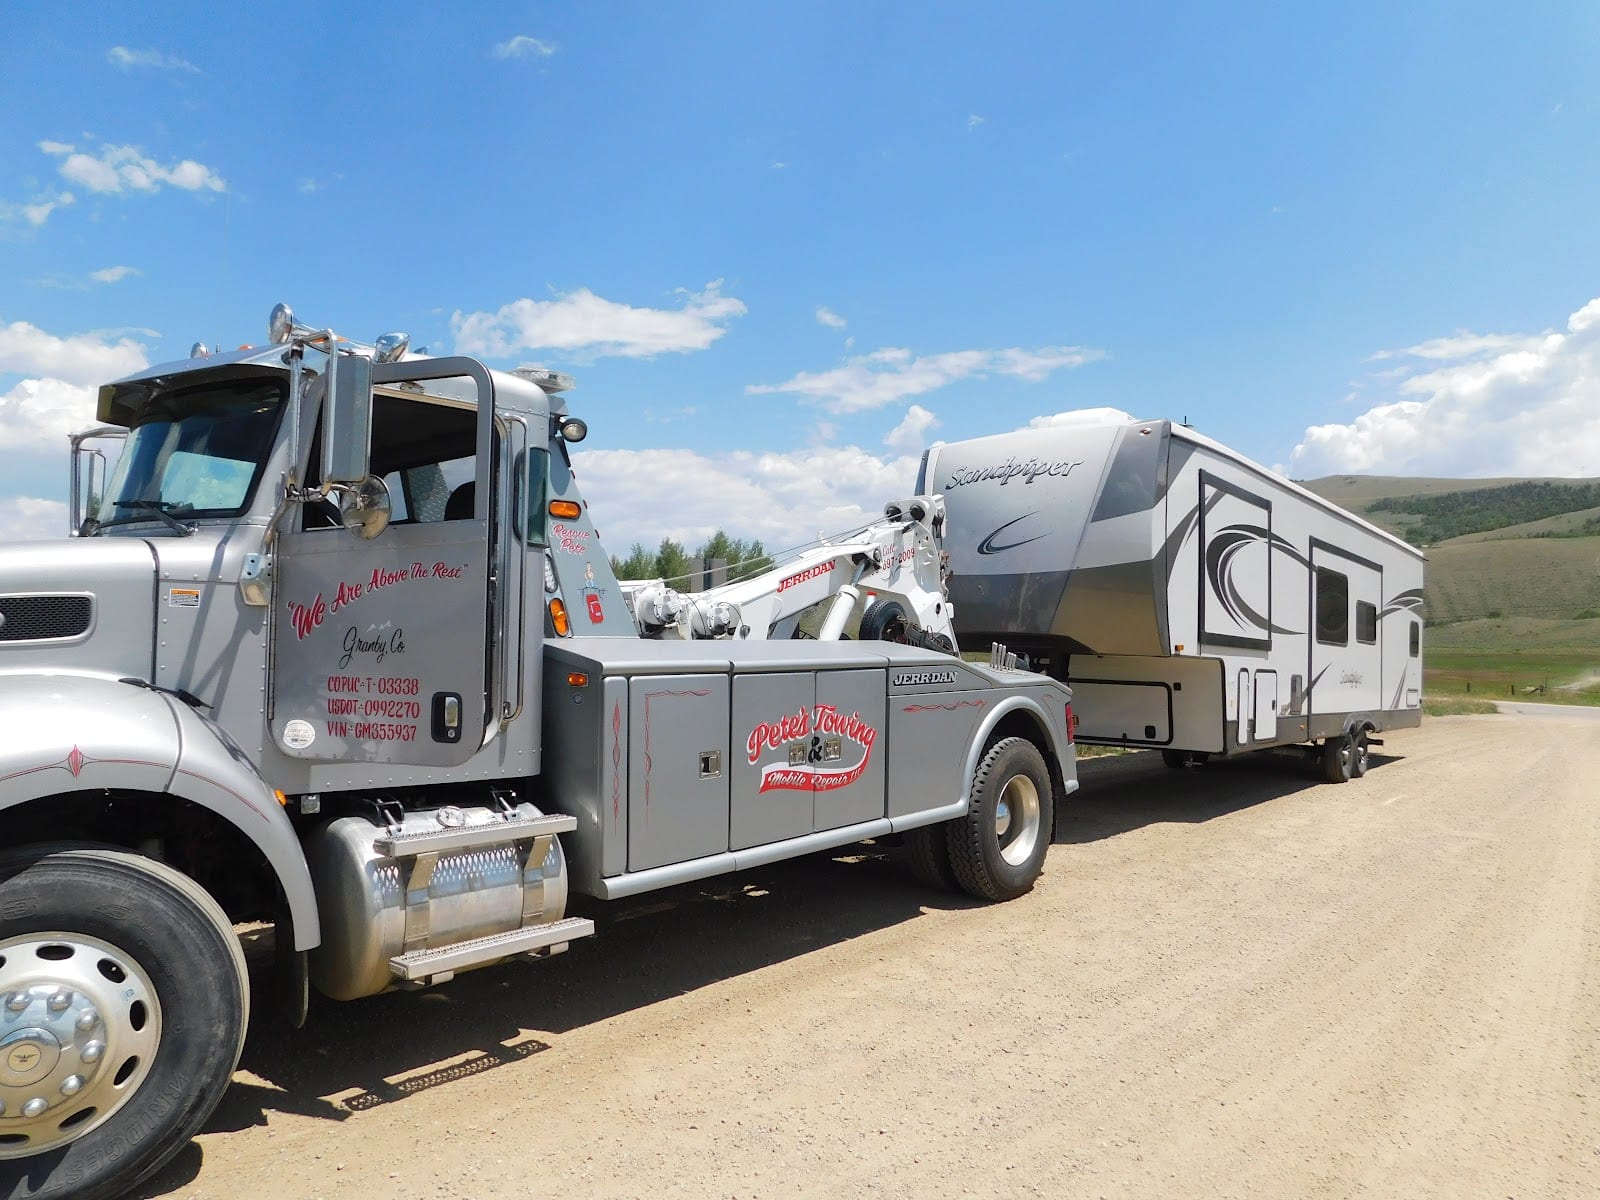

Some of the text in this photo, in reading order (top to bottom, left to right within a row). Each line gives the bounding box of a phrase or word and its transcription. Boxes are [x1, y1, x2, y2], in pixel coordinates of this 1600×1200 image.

[945, 456, 1085, 490] Sandpiper
[330, 582, 362, 615] Are
[366, 567, 408, 593] Above
[410, 562, 428, 579] The
[746, 703, 877, 765] Pete's Towing
[808, 736, 822, 763] &
[768, 772, 806, 787] Mobile
[811, 774, 848, 790] Repair
